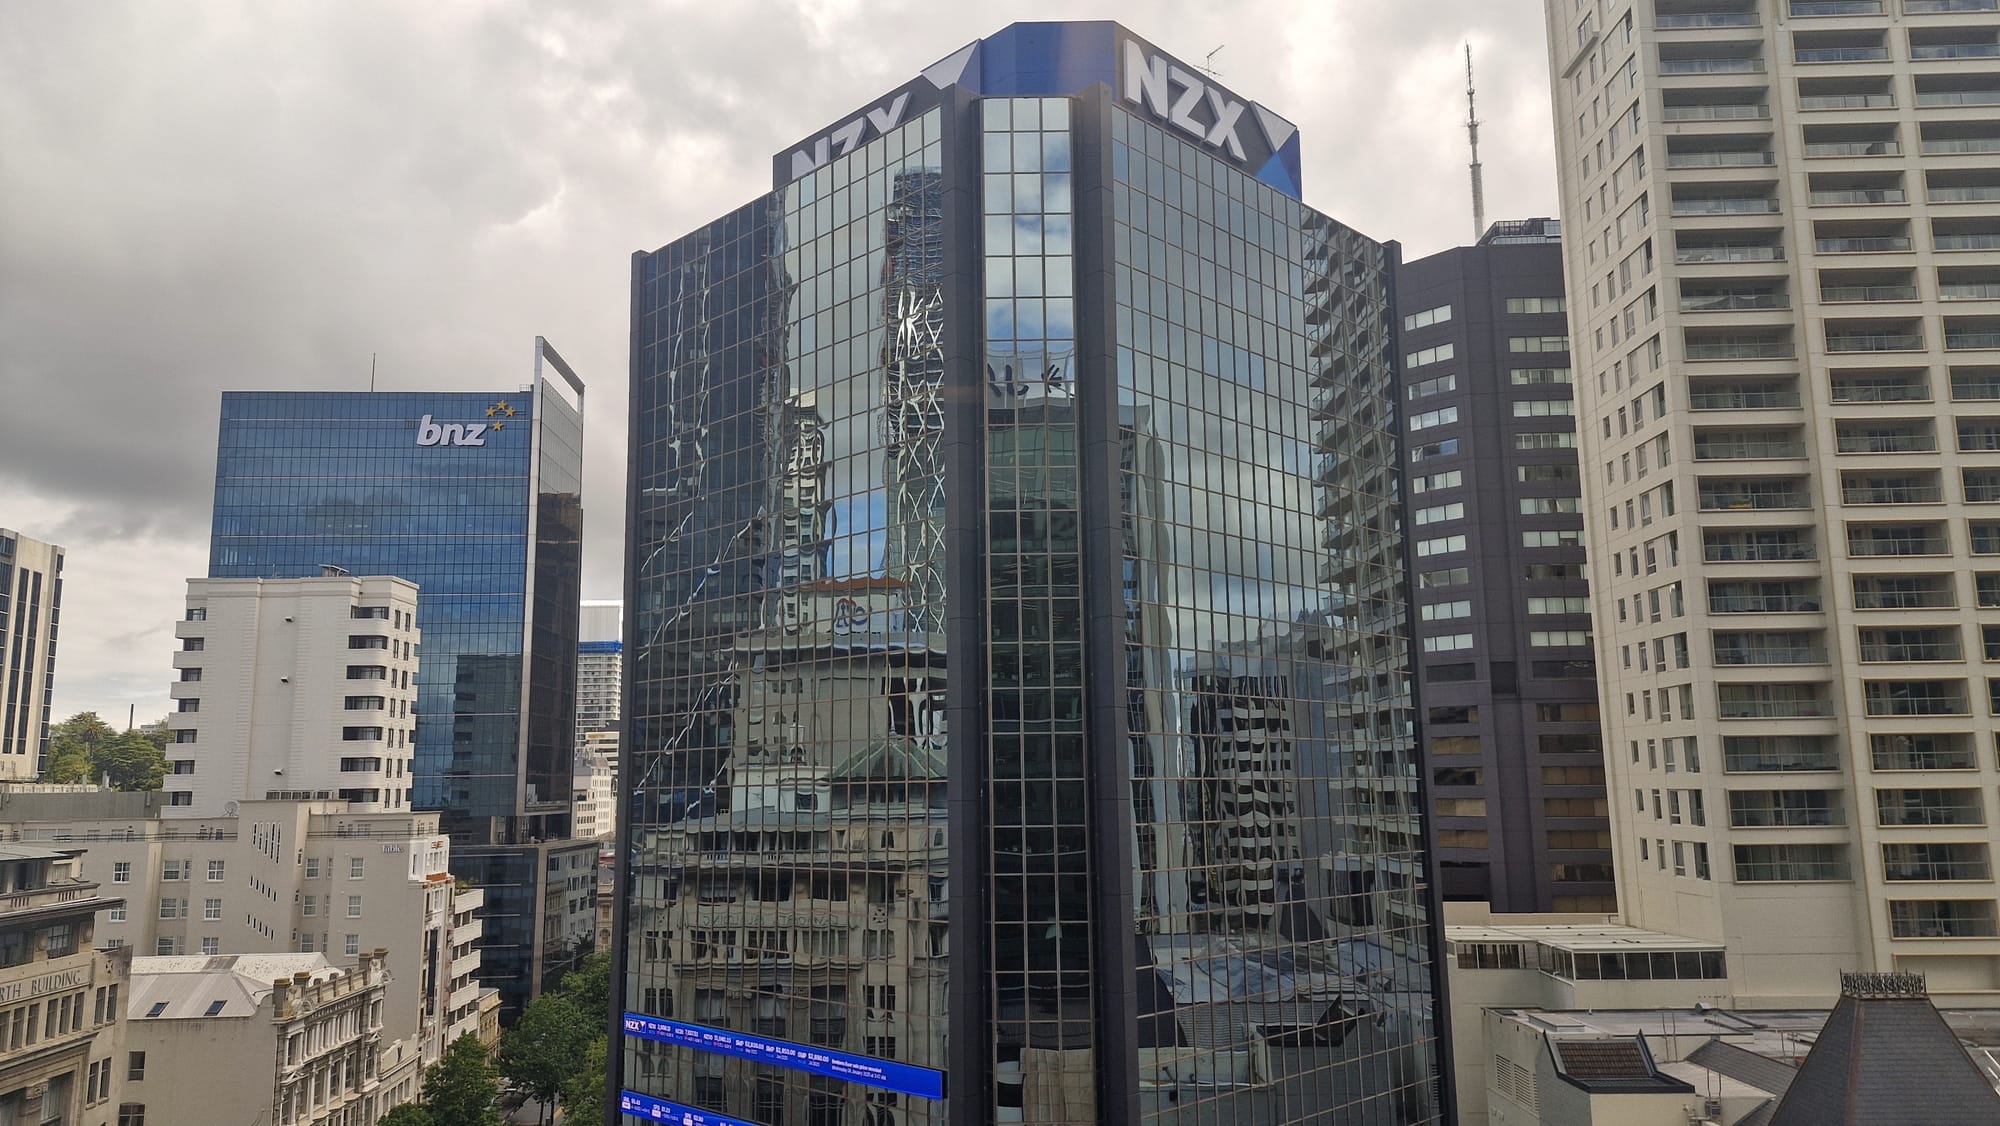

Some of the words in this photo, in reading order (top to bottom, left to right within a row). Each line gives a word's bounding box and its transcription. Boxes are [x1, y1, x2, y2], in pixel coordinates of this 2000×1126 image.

[1123, 38, 1248, 162] NZX
[416, 414, 488, 446] bnz
[31, 970, 81, 995] BUILDING
[625, 1020, 640, 1031] NZX
